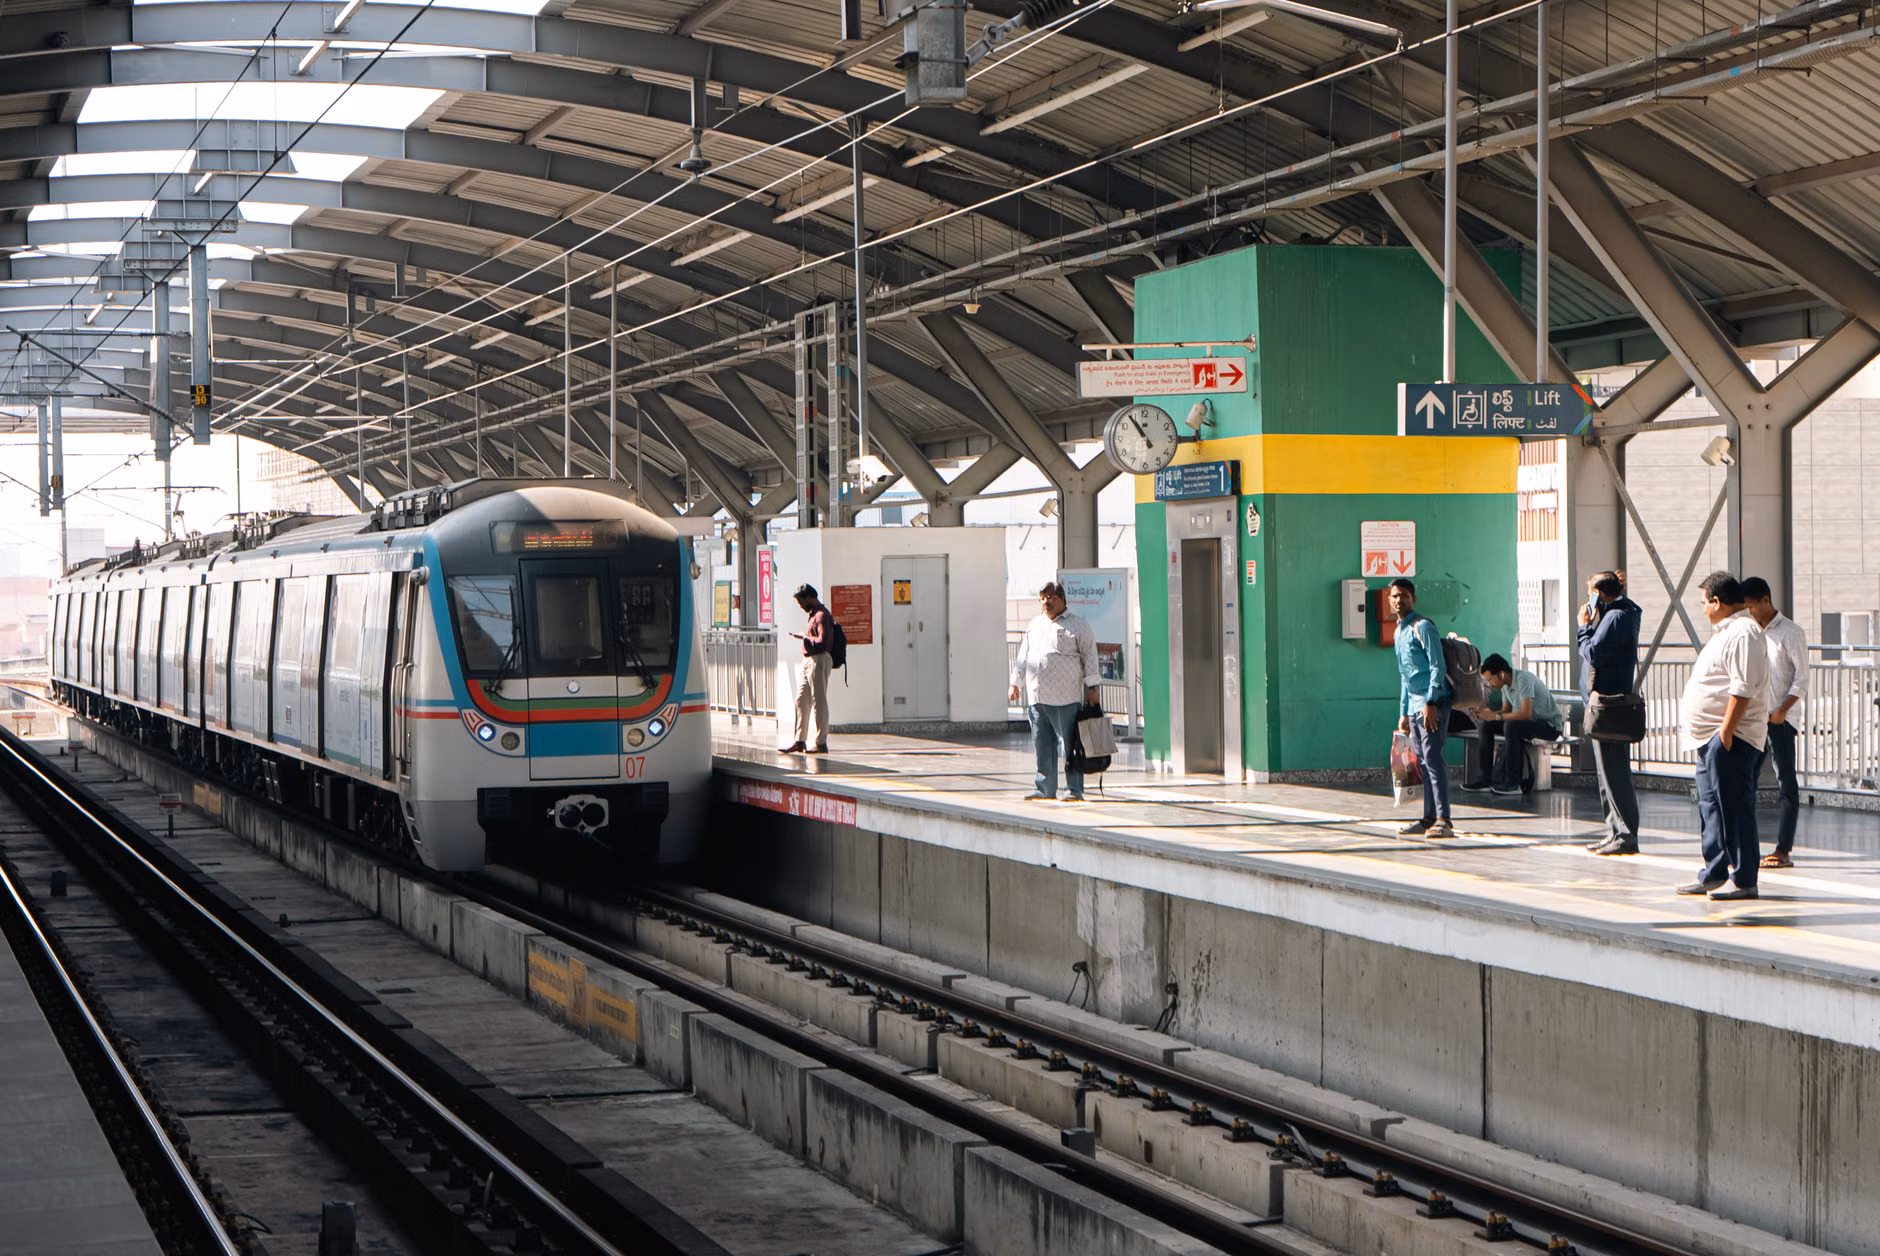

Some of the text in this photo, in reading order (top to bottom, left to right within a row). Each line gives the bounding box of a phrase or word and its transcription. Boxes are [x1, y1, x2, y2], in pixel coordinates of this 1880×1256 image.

[1535, 390, 1561, 406] Lift
[1141, 410, 1149, 418] 12
[1492, 413, 1525, 429] लिफ्ट
[1168, 435, 1173, 443] 3
[1163, 448, 1169, 456] 4
[1131, 457, 1136, 465] 7
[1156, 457, 1161, 465] 5
[1219, 465, 1224, 492] 1
[626, 756, 645, 778] 07
